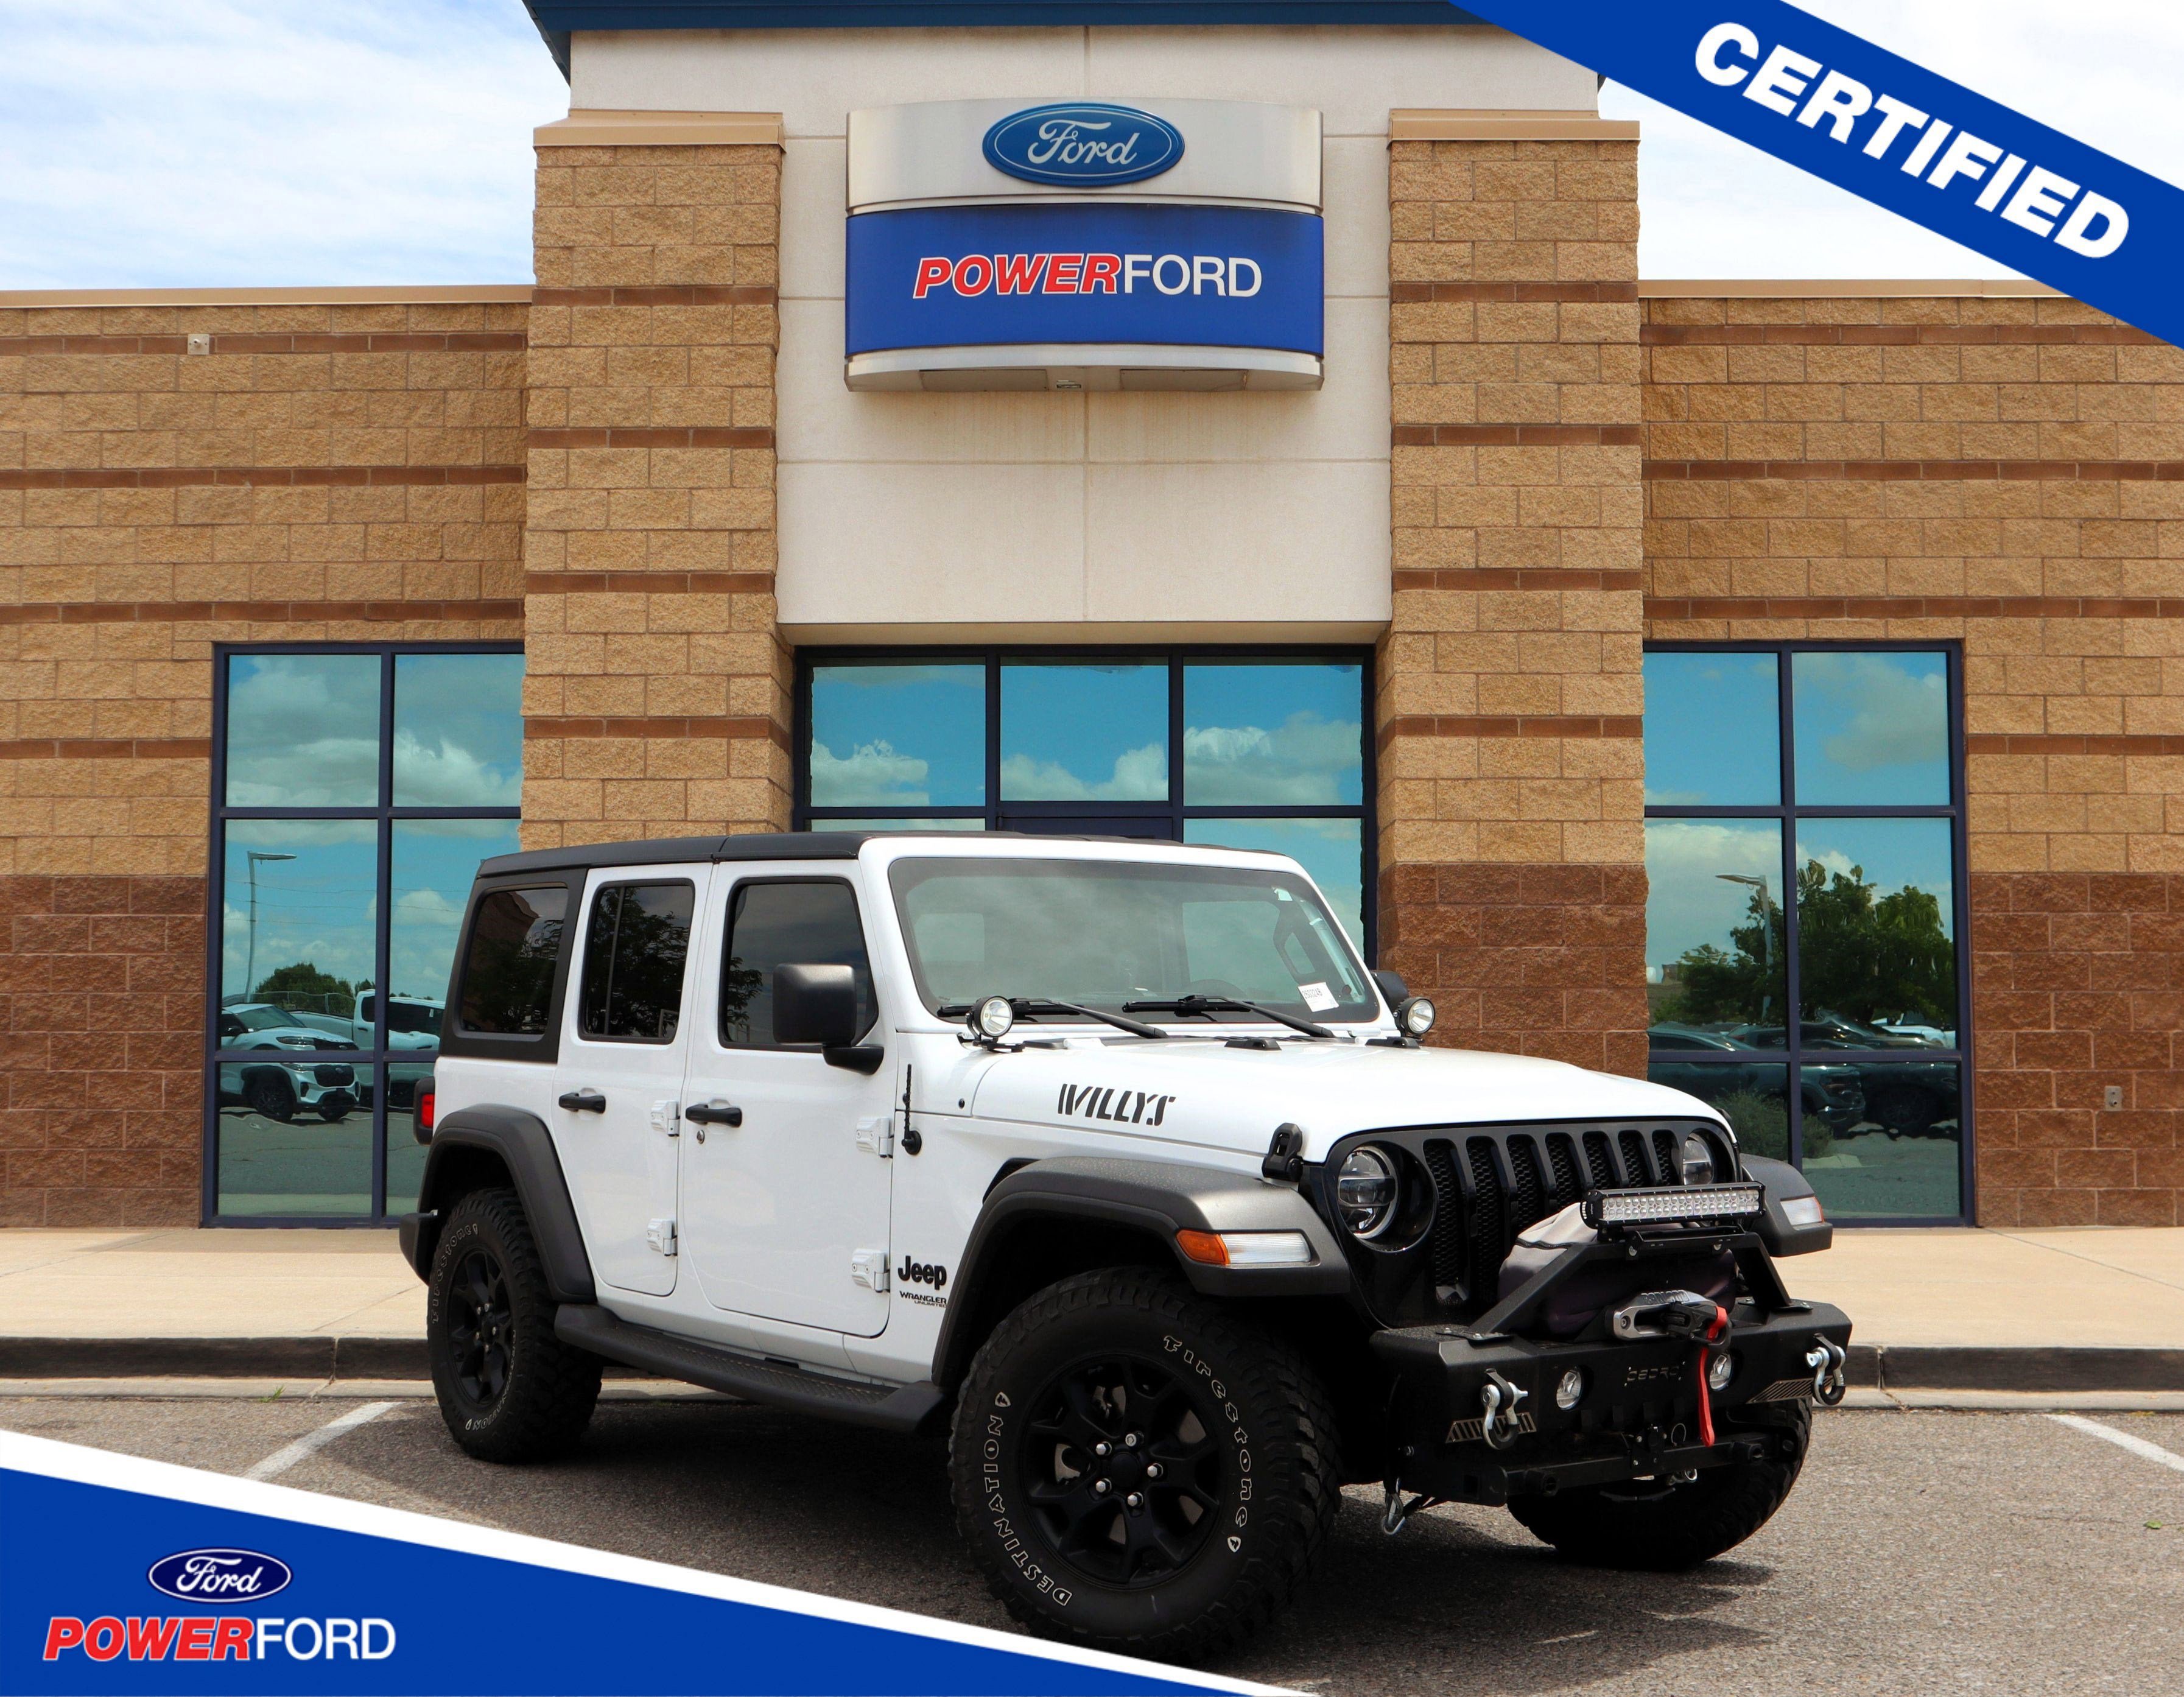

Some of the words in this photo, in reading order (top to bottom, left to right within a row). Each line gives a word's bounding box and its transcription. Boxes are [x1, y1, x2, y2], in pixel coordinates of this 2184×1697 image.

[1028, 119, 1137, 165] Ford
[913, 253, 1263, 299] POWERFORD
[1058, 1083, 1176, 1126] WILLYS
[897, 1256, 947, 1290] Jeep
[899, 1290, 947, 1304] WRANGLER
[1164, 1335, 1252, 1528] Firestone
[983, 1414, 1073, 1606] DESTINATION
